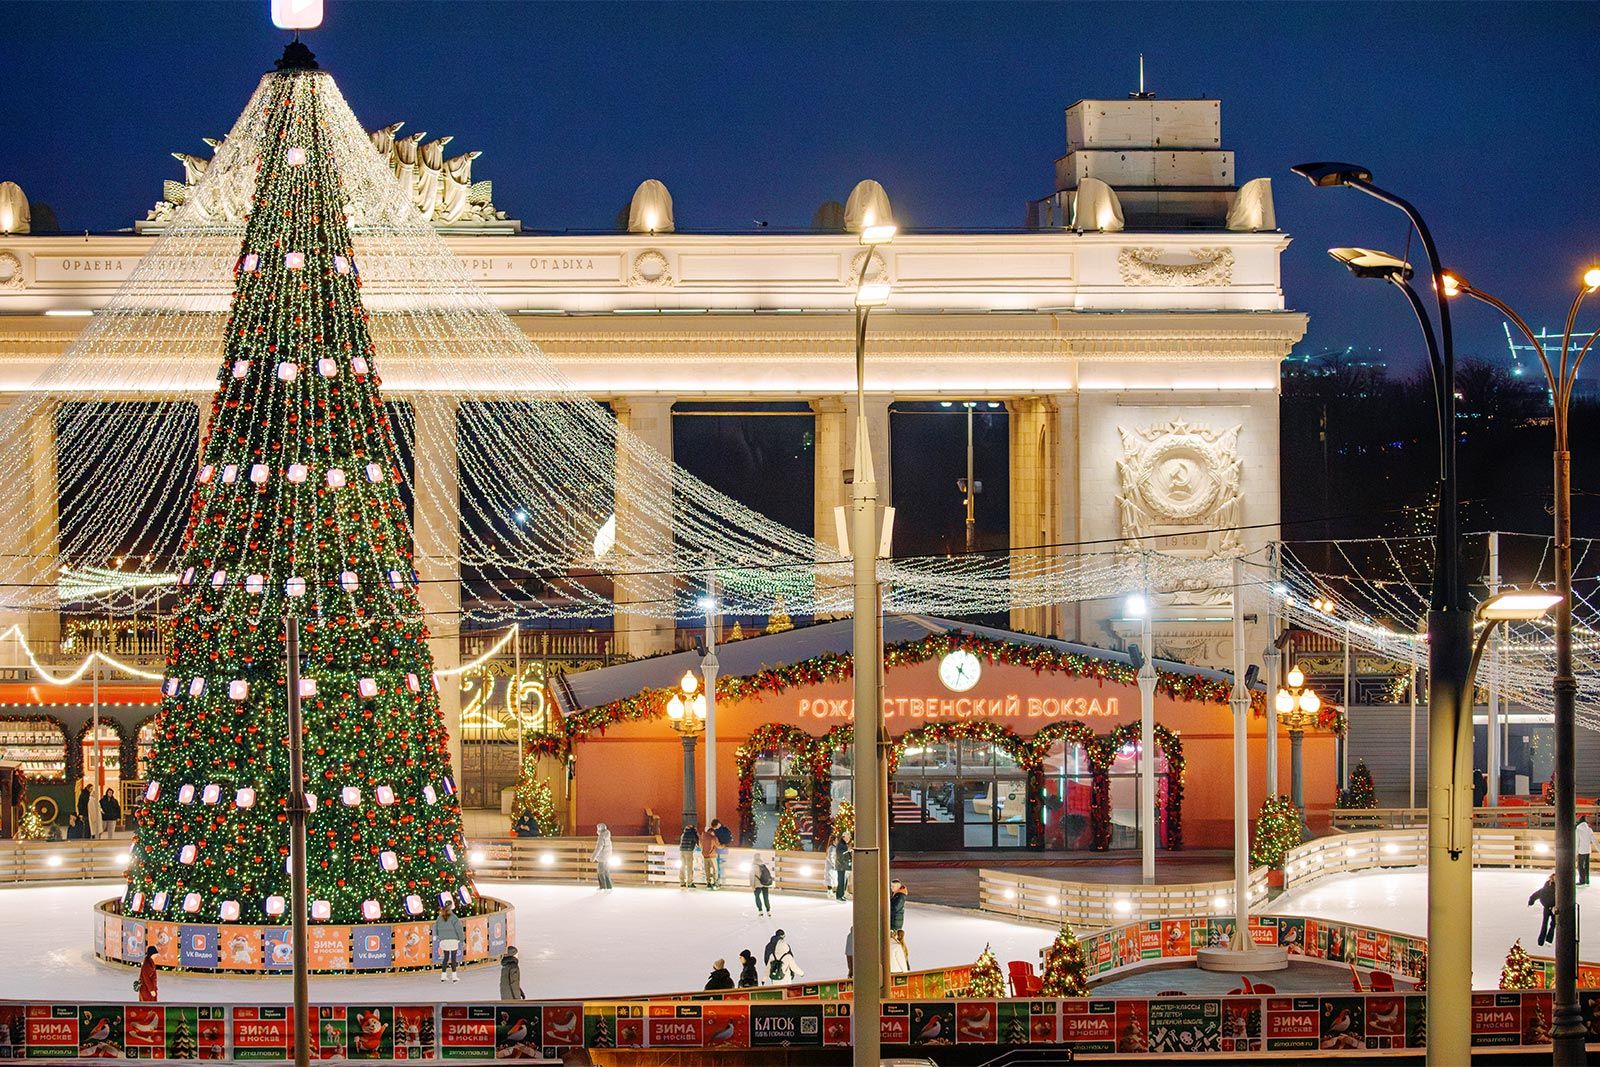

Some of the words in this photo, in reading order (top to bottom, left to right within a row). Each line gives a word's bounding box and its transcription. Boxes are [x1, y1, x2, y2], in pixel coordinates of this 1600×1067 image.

[62, 259, 123, 271] ОРДЕНА
[530, 258, 594, 270] ОТДЫХА
[799, 694, 1020, 720] РОЖСТВЕНСКИЙ
[1027, 697, 1119, 717] ВОКЗАЛ
[313, 940, 344, 949] ЗИМА
[755, 1017, 795, 1031] КАТОК
[1069, 1020, 1109, 1030] ЗИМА
[1273, 1015, 1313, 1026] ЗИМА
[32, 1024, 72, 1034] ЗИМА
[239, 1025, 280, 1035] ЗИМА
[448, 1024, 488, 1034] ЗИМА
[656, 1024, 696, 1034] ЗИМА
[881, 1022, 903, 1031] МА
